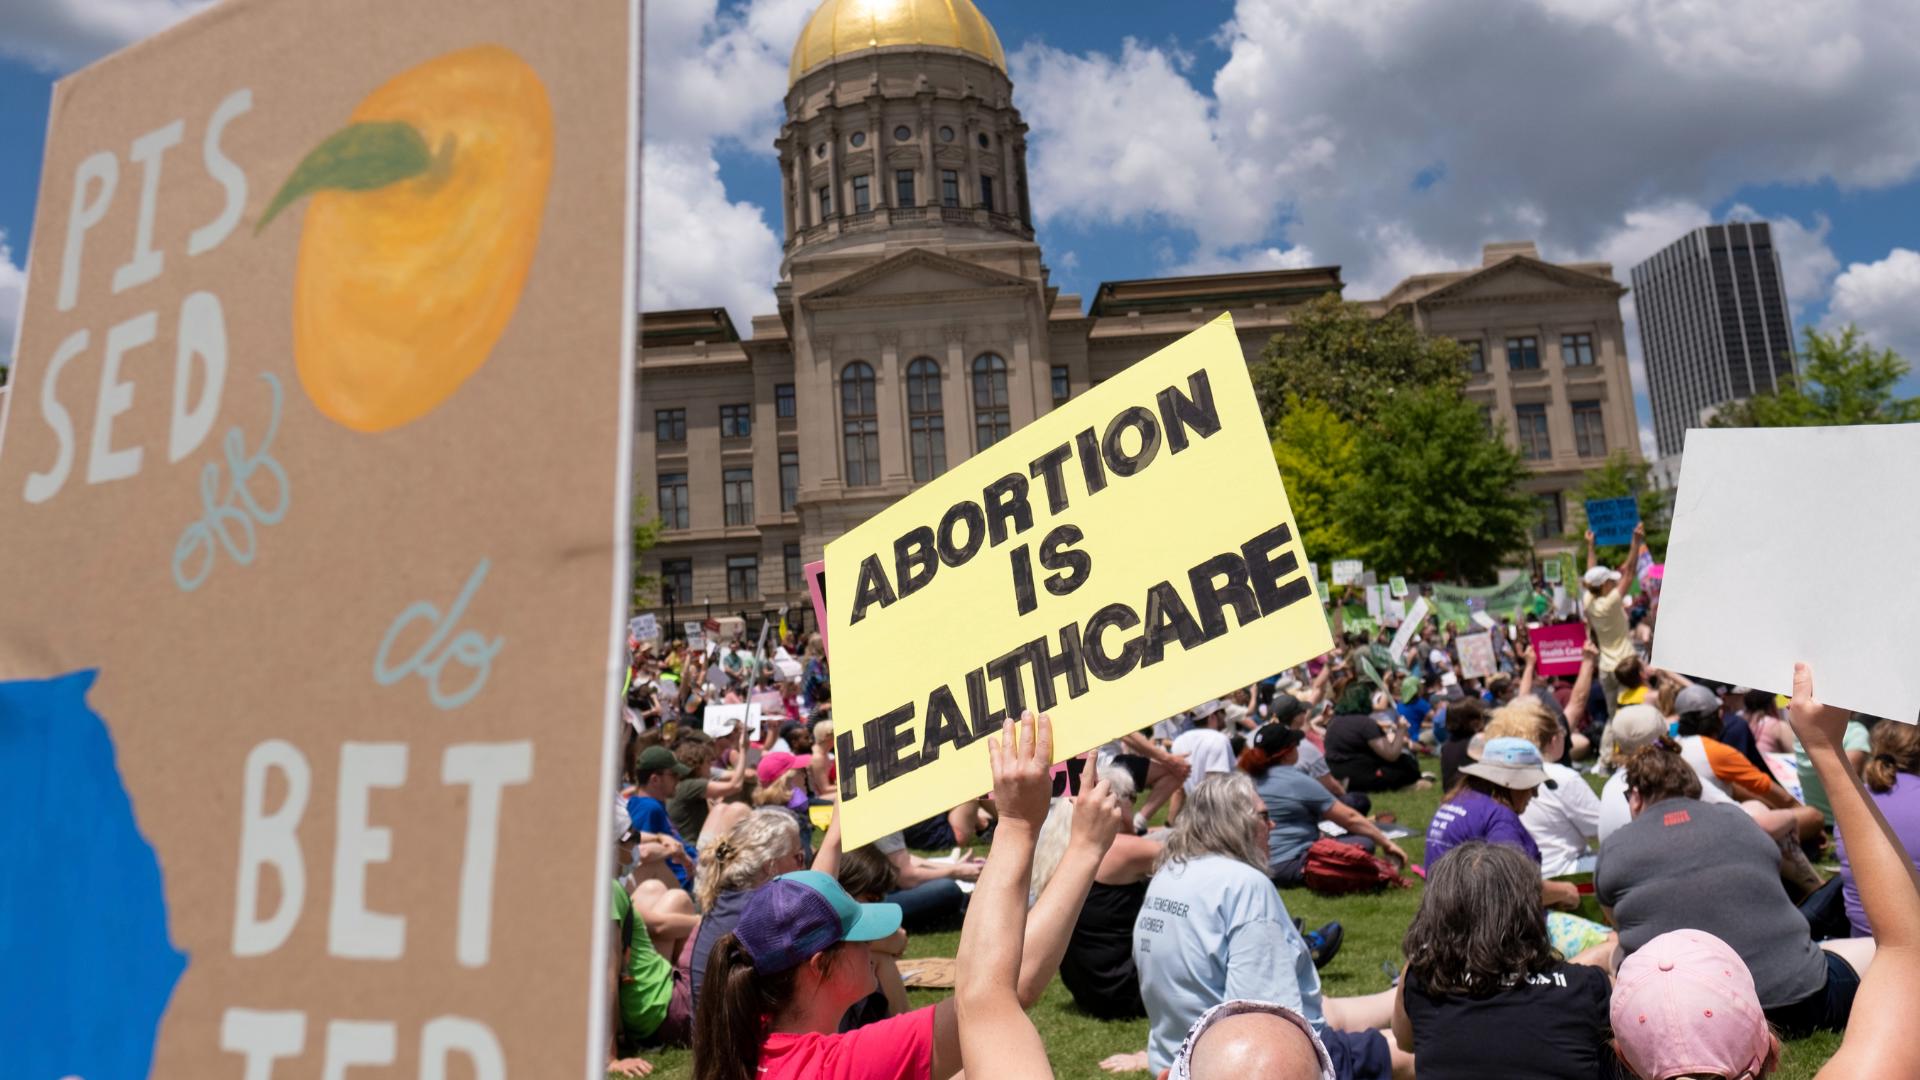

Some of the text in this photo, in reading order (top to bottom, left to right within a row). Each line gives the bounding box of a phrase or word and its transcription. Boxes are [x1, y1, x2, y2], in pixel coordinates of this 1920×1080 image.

[56, 88, 253, 312] PIS
[24, 291, 228, 504] SED
[172, 372, 290, 592] off
[850, 367, 1222, 626] ABORTION
[373, 557, 506, 710] do
[836, 522, 1312, 802] HEALTHCARE
[1010, 523, 1092, 616] IS
[232, 739, 534, 967] BET
